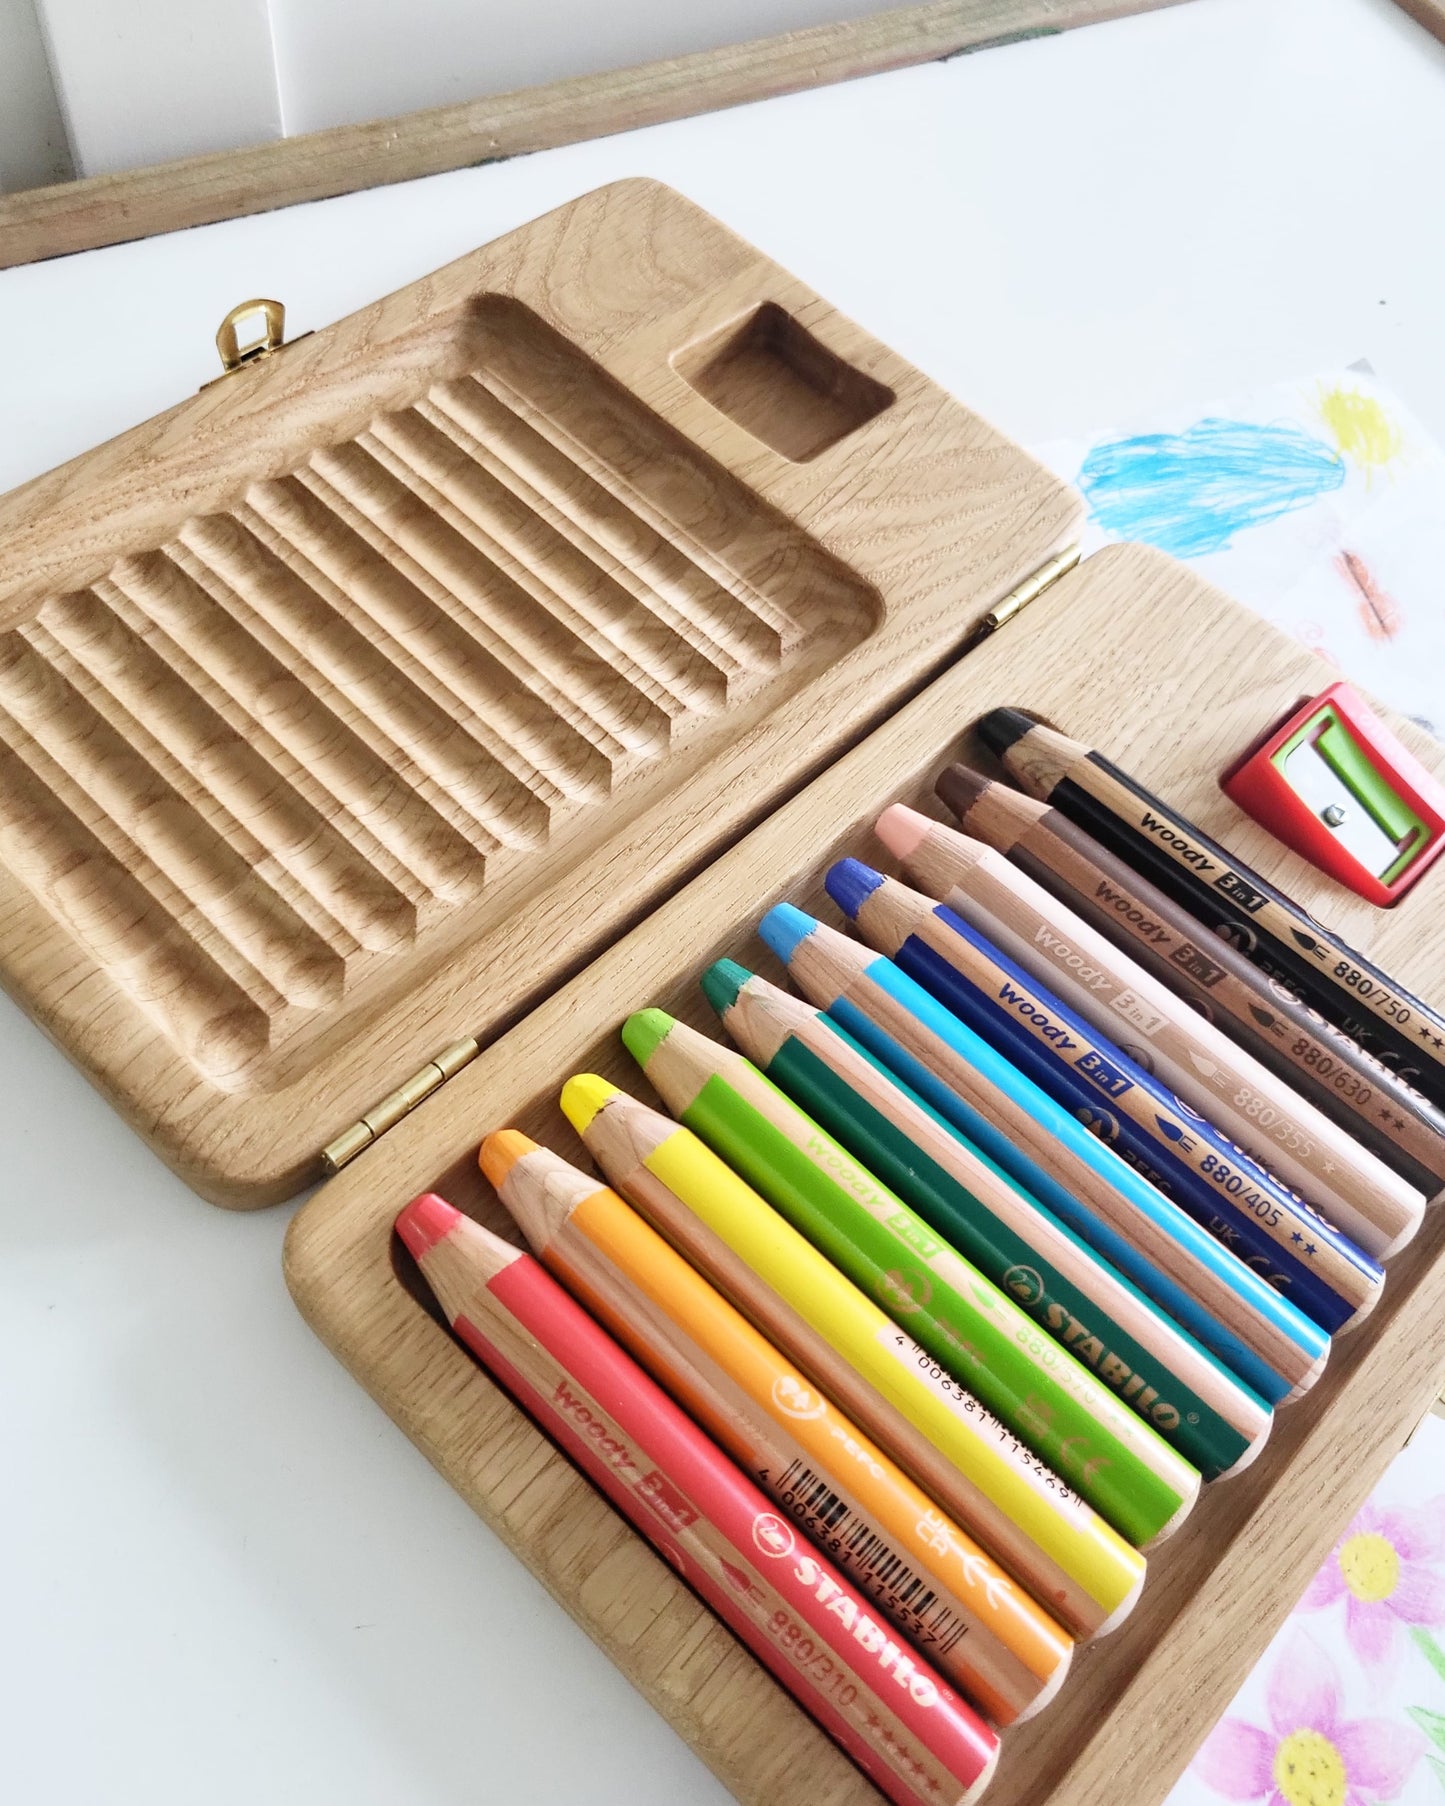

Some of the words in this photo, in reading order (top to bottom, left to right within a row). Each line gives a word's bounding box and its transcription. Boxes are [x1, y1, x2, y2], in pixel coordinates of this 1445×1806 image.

[1141, 812, 1215, 871] woody
[1219, 875, 1238, 889] 3
[1246, 896, 1263, 909] 1
[1095, 881, 1171, 944] woody
[1174, 949, 1192, 961] 3
[1033, 925, 1113, 990] woody
[1116, 995, 1133, 1009] 3
[1145, 1017, 1162, 1030] 1
[1333, 961, 1411, 1024] 880/750
[999, 982, 1077, 1050] woody
[1081, 1055, 1101, 1070] 3
[1109, 1078, 1127, 1093] 1
[1292, 1038, 1372, 1105] 880/630
[1234, 1088, 1315, 1157] 880/355
[807, 1135, 886, 1206] woody
[1200, 1154, 1284, 1227] 880/405
[1044, 1303, 1180, 1430] STABILO
[553, 1380, 636, 1468] woody
[830, 1426, 885, 1480] PEFC
[895, 1335, 905, 1346] 4
[918, 1356, 986, 1422] 006381
[999, 1431, 1069, 1498] 115469
[758, 1468, 770, 1482] 4
[781, 1491, 853, 1563] 006381
[863, 1571, 936, 1646] 115537
[768, 1610, 858, 1706] 880/310
[794, 1556, 938, 1707] STABILO
